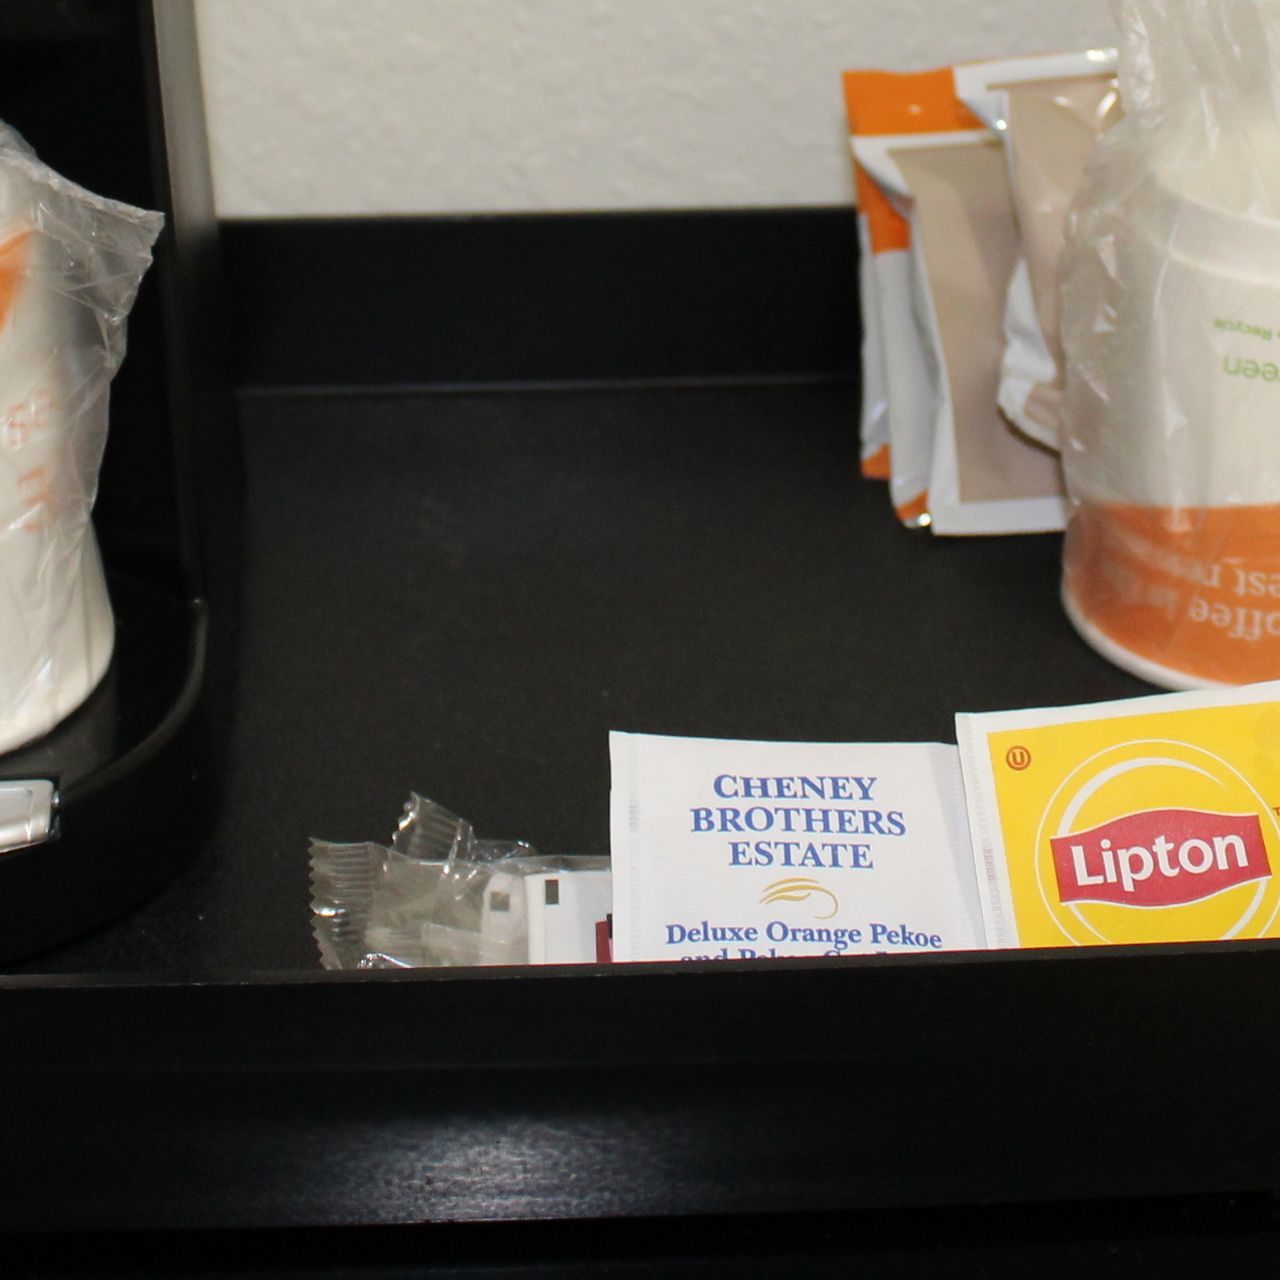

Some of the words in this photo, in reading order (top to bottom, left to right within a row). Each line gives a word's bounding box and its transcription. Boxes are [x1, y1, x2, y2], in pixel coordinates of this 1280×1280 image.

[713, 774, 877, 801] CHENEY
[690, 806, 906, 836] BROTHERS
[728, 841, 874, 869] ESTATE
[1070, 832, 1249, 893] Lipton
[665, 920, 758, 945] Deluxe
[765, 921, 862, 950] Orange
[869, 923, 943, 949] Pekoe
